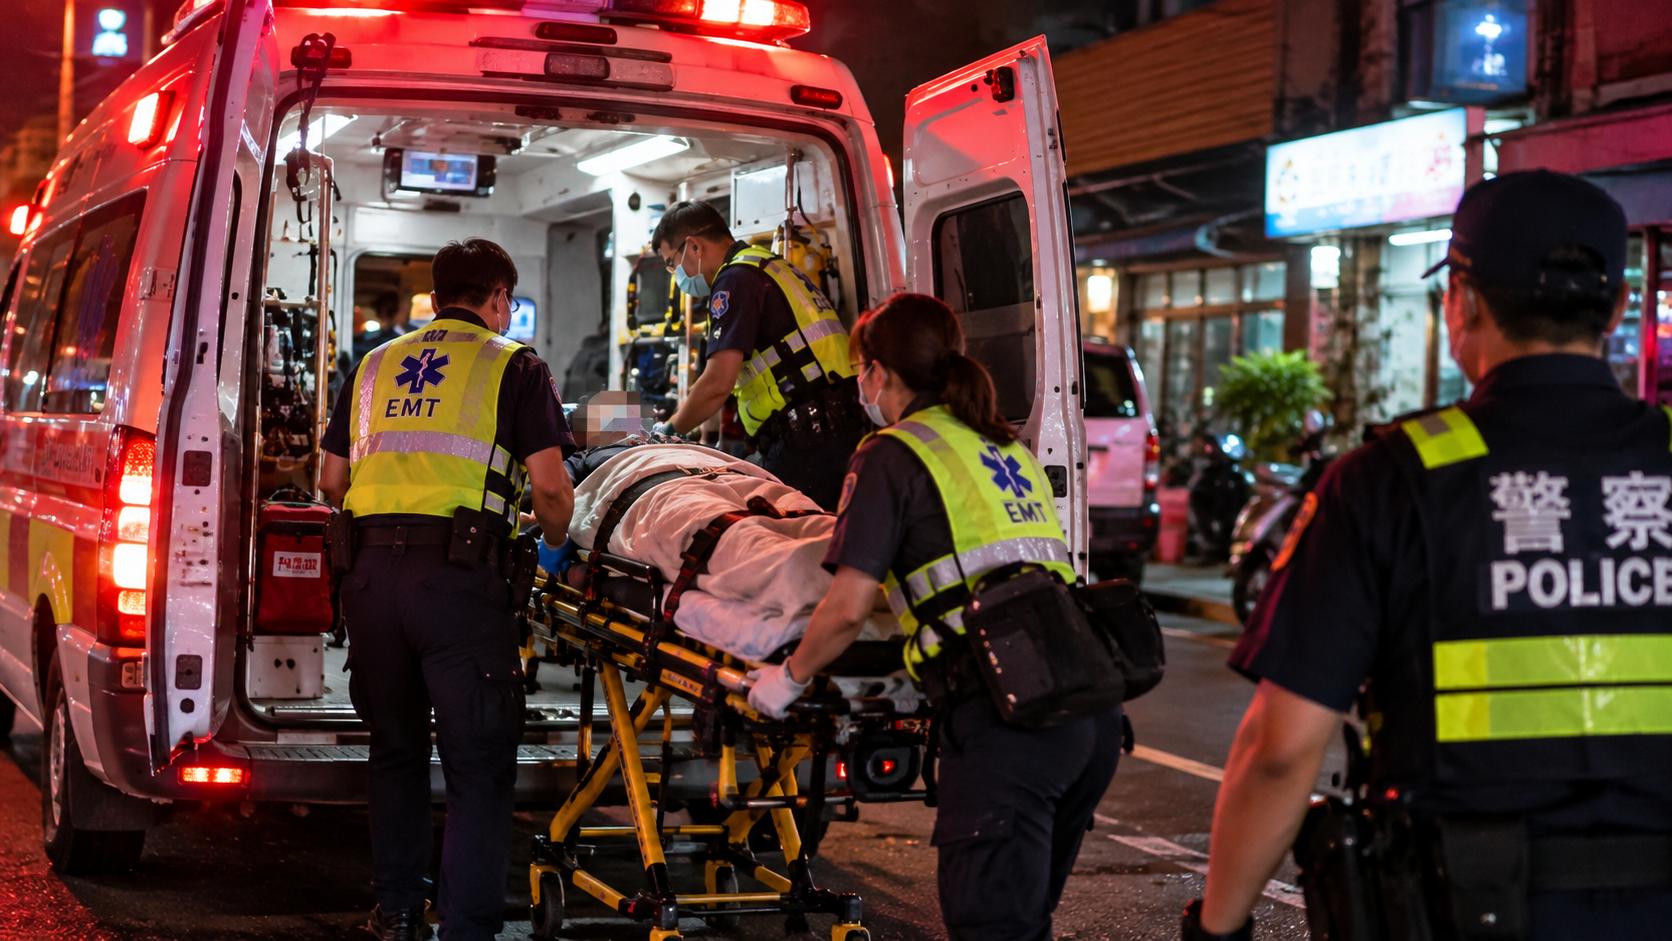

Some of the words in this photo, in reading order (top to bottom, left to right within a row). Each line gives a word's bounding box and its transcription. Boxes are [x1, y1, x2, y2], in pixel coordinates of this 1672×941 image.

[384, 397, 442, 418] EMT
[1003, 502, 1048, 524] EMT
[1489, 470, 1672, 554] 警察
[1491, 556, 1672, 611] POLICE
